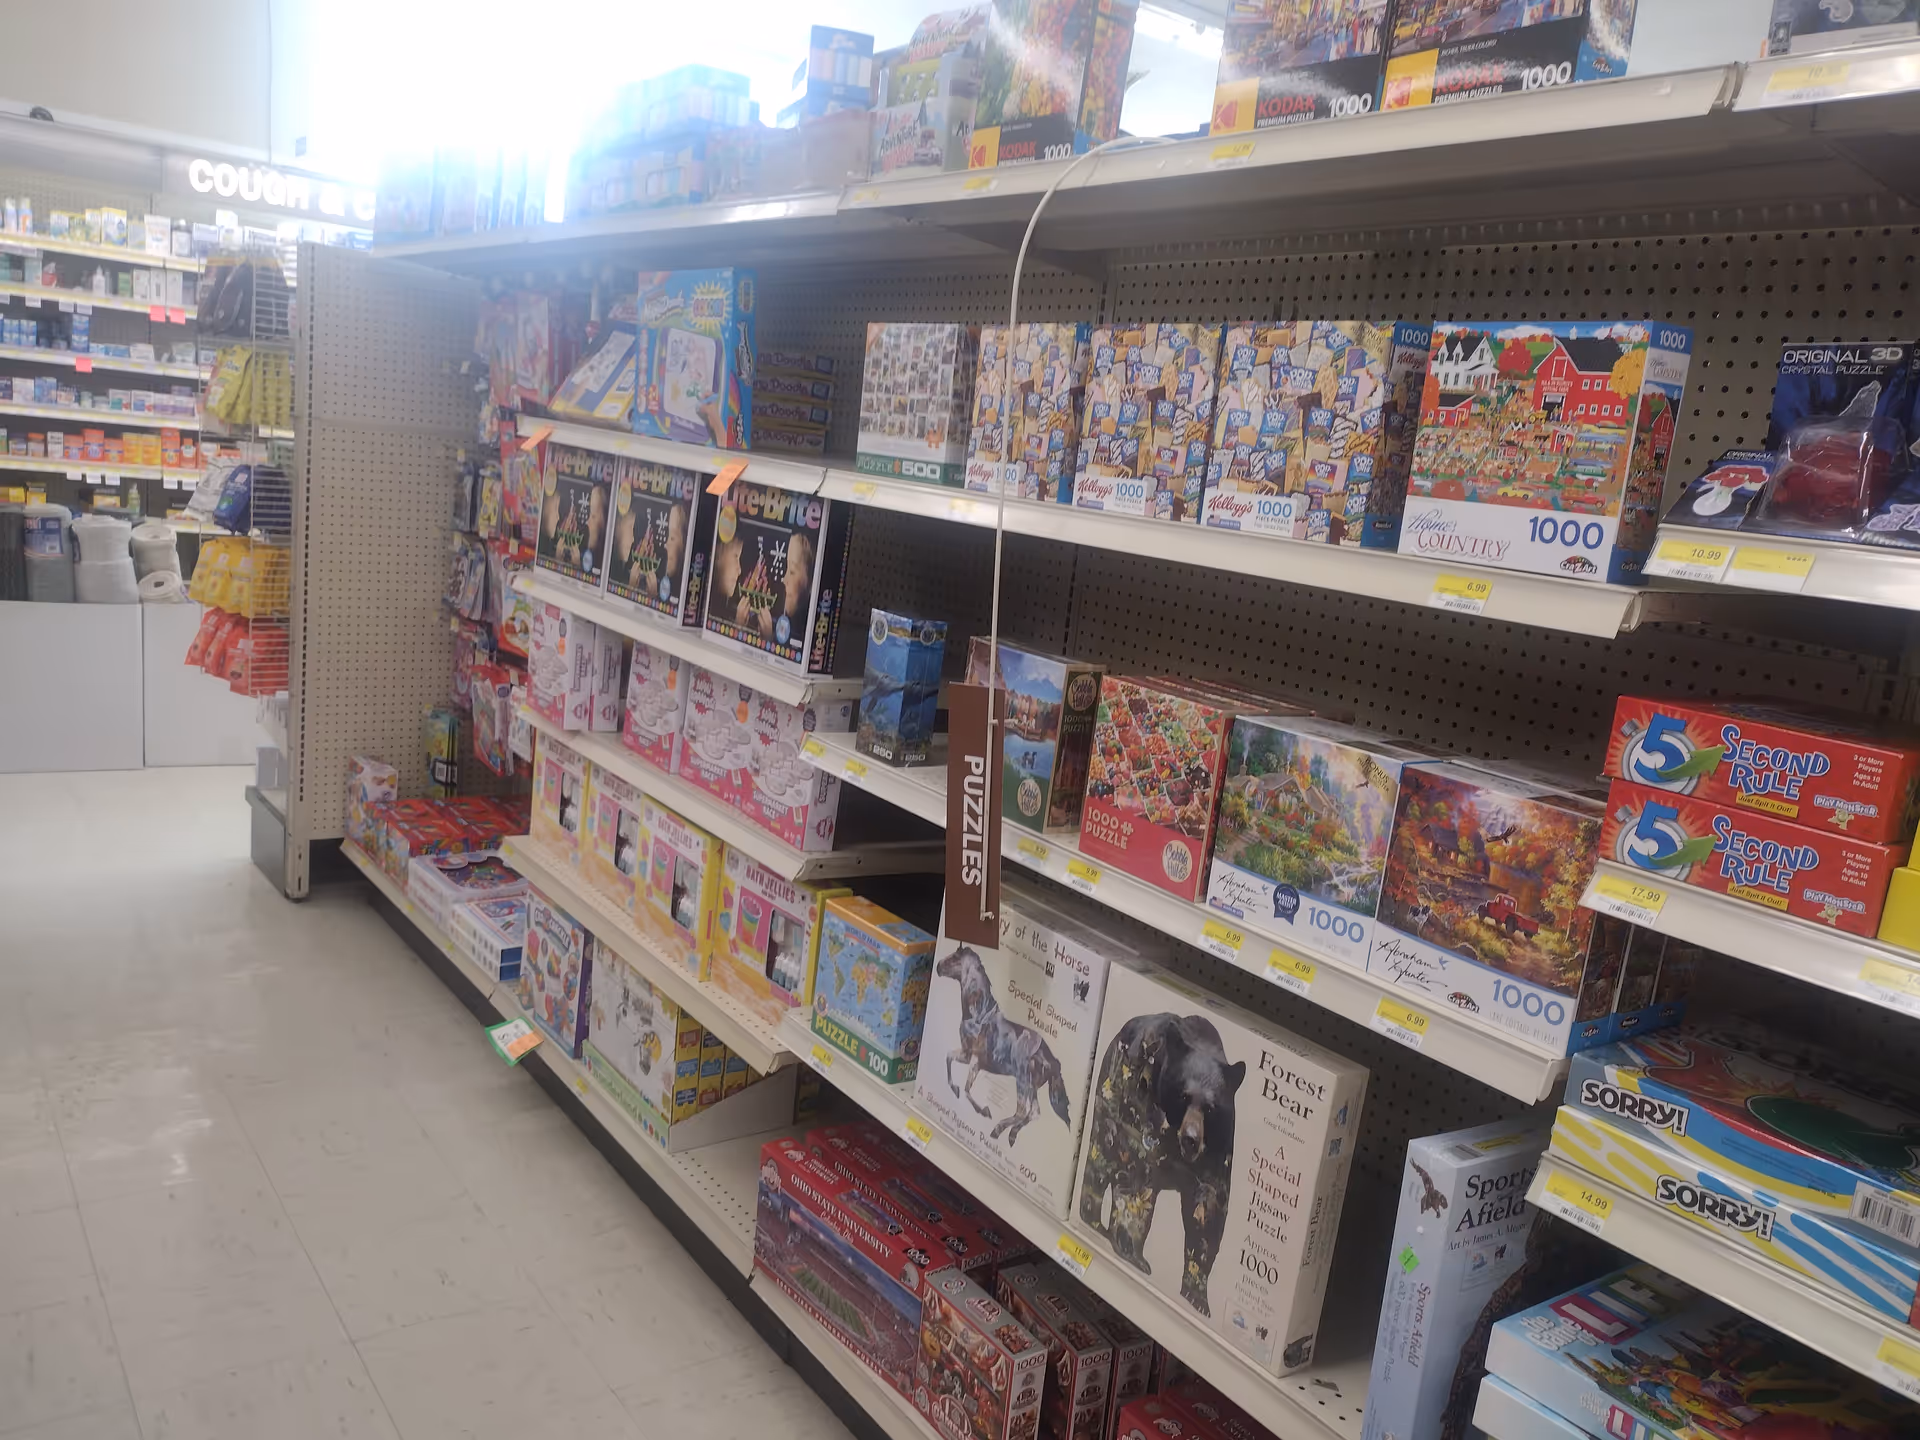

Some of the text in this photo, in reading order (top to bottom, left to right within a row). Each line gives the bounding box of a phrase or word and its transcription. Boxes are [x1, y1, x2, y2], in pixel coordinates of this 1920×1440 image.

[1435, 61, 1572, 95] KODAK 1000
[1257, 93, 1372, 118] KODAK 1000
[1000, 141, 1072, 160] KODAK 1000
[189, 159, 310, 210] COUGH
[1399, 328, 1429, 346] 1000
[1660, 330, 1686, 349] 1000
[1783, 347, 1903, 364] ORIGINAL 3D
[1781, 365, 1884, 375] CRYSTAL PUZZLE
[996, 464, 1017, 481] 100
[1077, 477, 1144, 498] Kellogg's 1000
[1208, 494, 1292, 517] Kellogg's 1000
[1418, 530, 1509, 558] COUNTRY
[1529, 516, 1604, 549] 1000
[1691, 548, 1721, 561] 10.99
[1466, 581, 1487, 593] 6.99
[1634, 713, 1830, 783] 5 SECOND
[1867, 757, 1884, 766] More
[1729, 762, 1804, 801] RULE
[1861, 782, 1879, 791] Adult
[961, 754, 984, 887] PUZZLES
[1087, 806, 1120, 829] 1000
[1085, 820, 1129, 850] PUZZLE
[1627, 800, 1819, 871] 5 SECOND
[1855, 853, 1872, 863] More
[746, 866, 797, 904] BATH JELLIES
[1085, 867, 1098, 878] 9.99
[1720, 851, 1794, 894] RULE
[1848, 877, 1867, 887] Adult
[1860, 872, 1868, 880] 10
[1276, 889, 1298, 905] MASTER
[1277, 898, 1296, 912] ARTIST
[1631, 885, 1661, 902] 17.99
[1226, 930, 1241, 943] 6.99
[1308, 906, 1365, 943] 1000
[1015, 925, 1027, 940] of
[1032, 930, 1048, 953] the
[1054, 940, 1090, 977] Horse
[1295, 961, 1311, 975] 6.99
[1376, 939, 1565, 1026] Abraham 1000
[1008, 979, 1078, 1033] Special Shaped
[1406, 1012, 1425, 1027] 6.99
[1027, 1007, 1058, 1040] Puzzle
[815, 1015, 859, 1057] PUZZLE
[868, 1051, 889, 1077] 100
[1258, 1048, 1327, 1102] Forest
[1261, 1077, 1314, 1120] Bear
[1582, 1080, 1689, 1137] SORRY!
[951, 1109, 976, 1138] Jigsaw
[1274, 1145, 1286, 1161] A
[834, 1160, 854, 1181] OHIO
[1251, 1147, 1302, 1188] Special
[1247, 1168, 1300, 1209] Shaped
[1580, 1189, 1608, 1211] 14.99
[791, 1173, 892, 1258] OHIO STATE UNIVERSITY
[1249, 1191, 1291, 1224] Jigsaw
[1455, 1196, 1526, 1233] Afield
[1656, 1175, 1776, 1241] SORRY!
[1246, 1209, 1288, 1244] Puzzle
[1302, 1195, 1323, 1267] Forest Bear
[907, 1247, 930, 1265] 1000
[1072, 1245, 1090, 1262] 11.99
[1243, 1234, 1280, 1263] Approx.
[1239, 1248, 1279, 1285] 1000
[1408, 1282, 1431, 1369] Sports Afield
[1016, 1354, 1046, 1370] 1000
[1080, 1352, 1111, 1368] 1000
